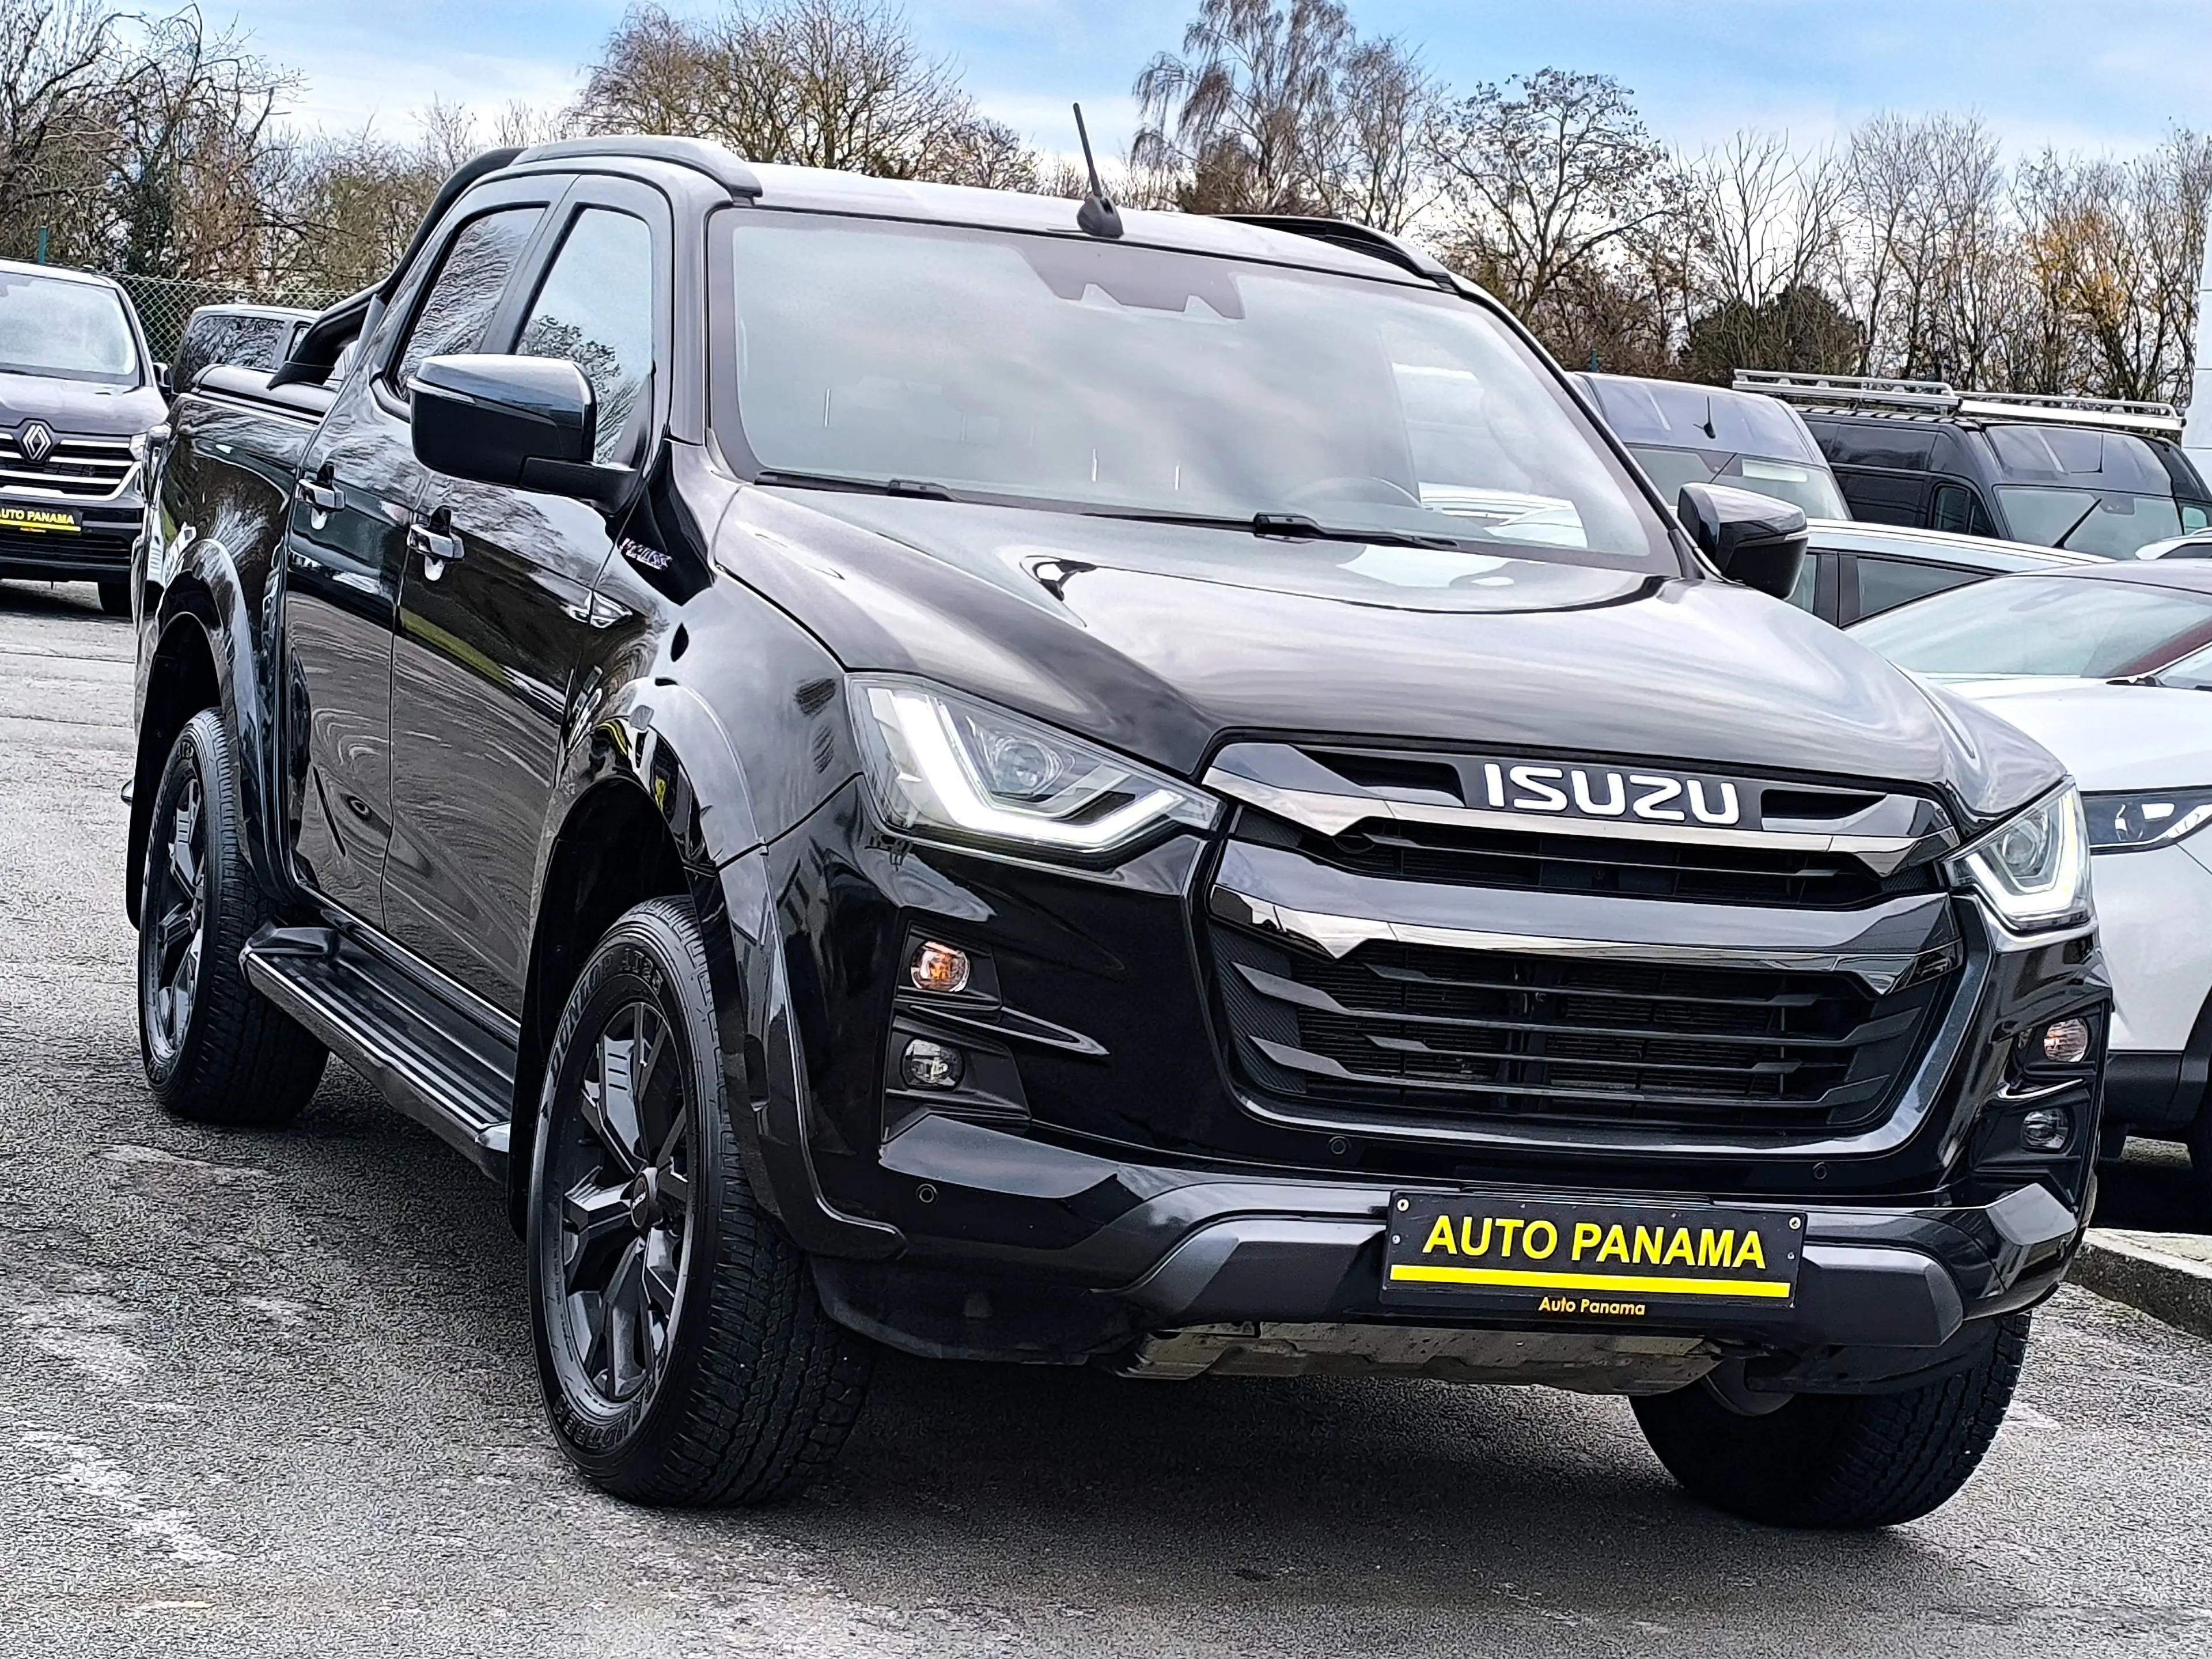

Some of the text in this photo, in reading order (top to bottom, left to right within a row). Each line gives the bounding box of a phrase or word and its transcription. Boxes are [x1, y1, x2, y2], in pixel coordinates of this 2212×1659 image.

[0, 507, 75, 525] UTO PANAMA
[1483, 763, 1740, 825] ISUZU
[1422, 1214, 1767, 1270] AUTO PANAMA
[1538, 1296, 1646, 1316] Auto Panama
